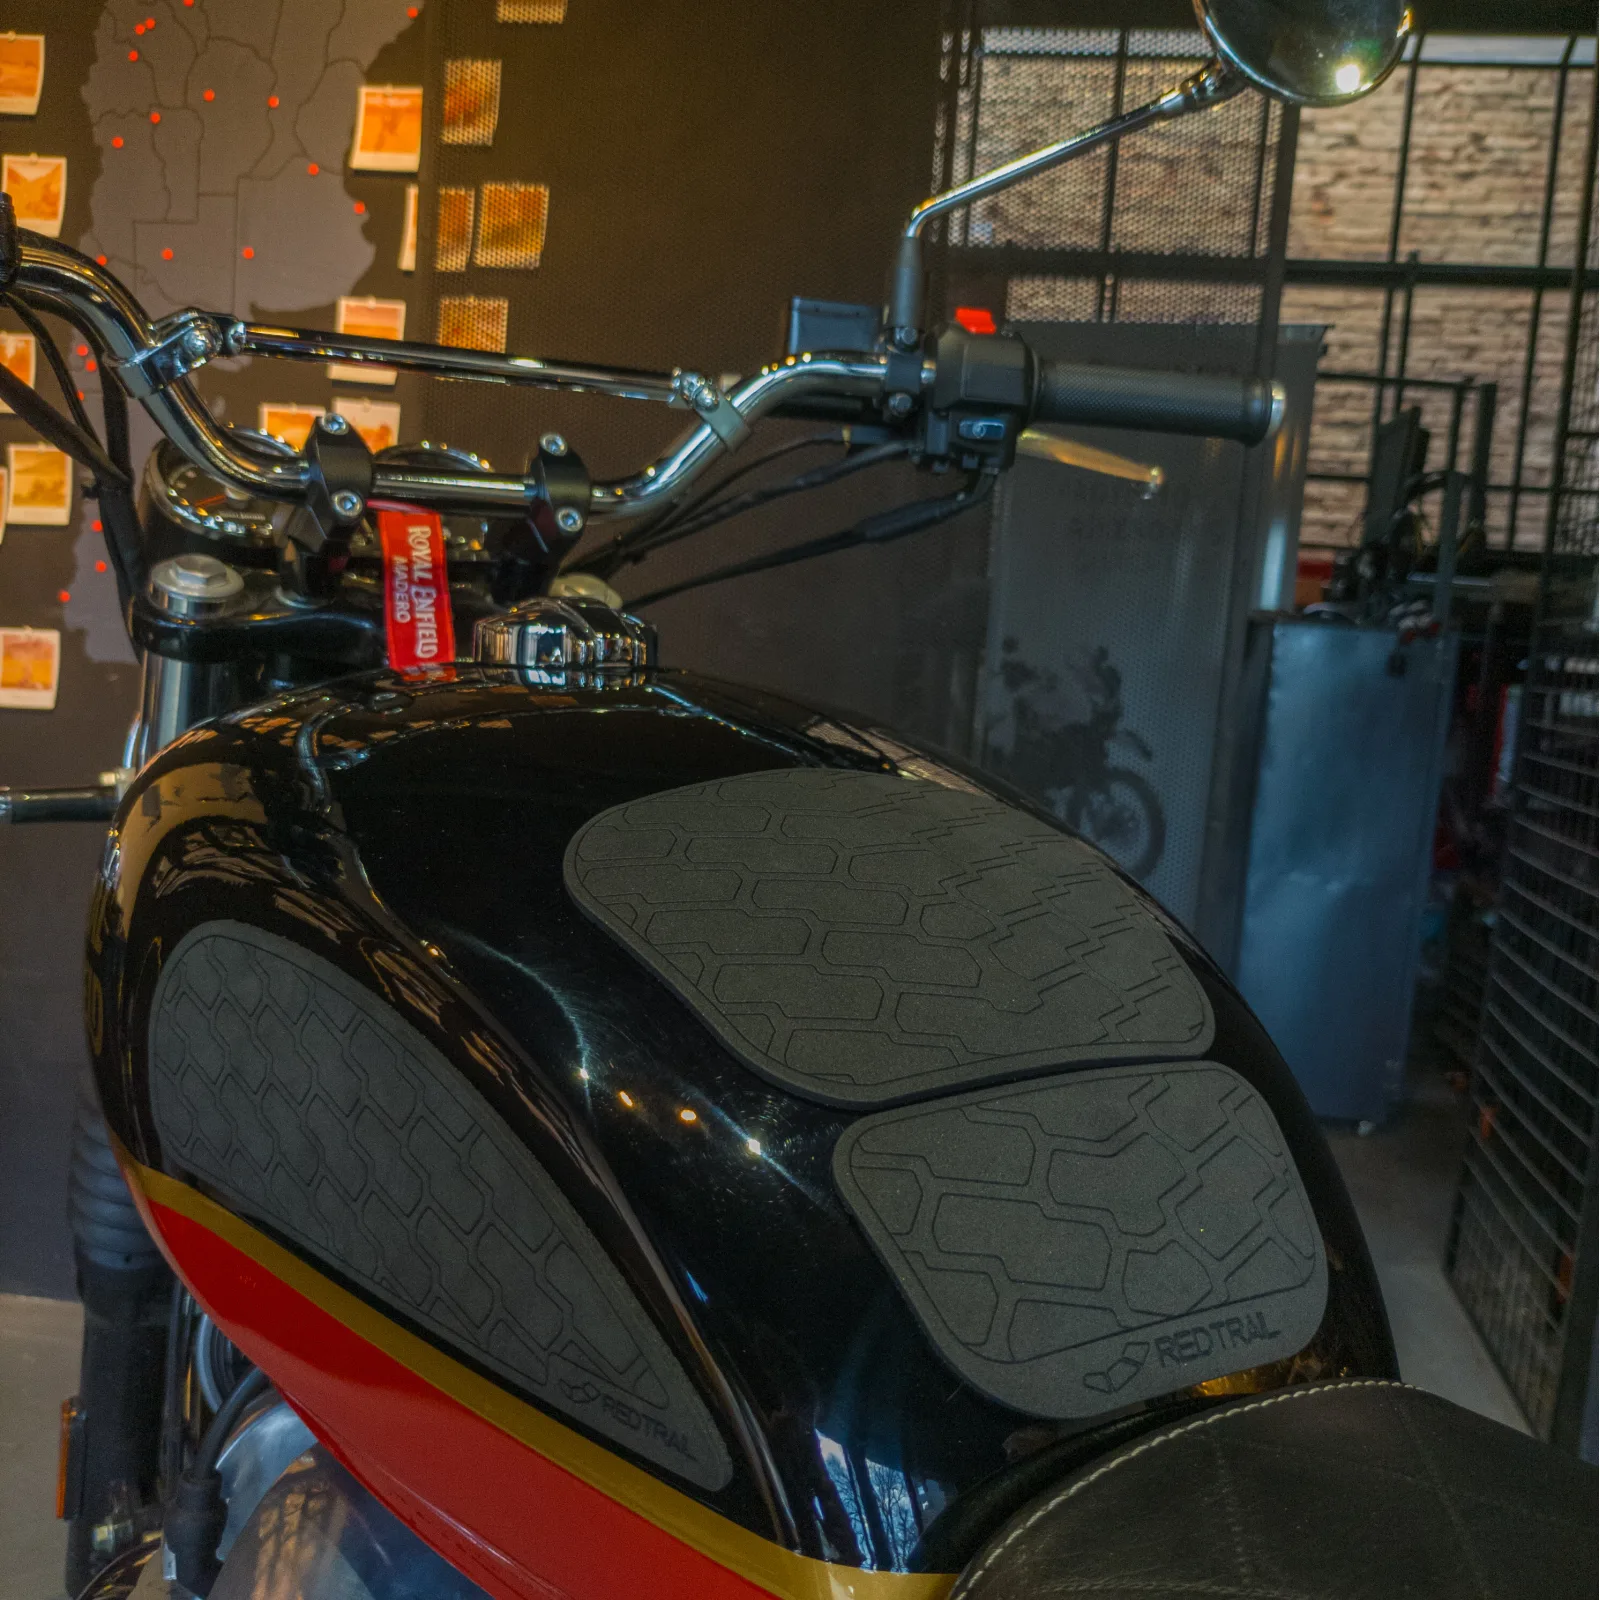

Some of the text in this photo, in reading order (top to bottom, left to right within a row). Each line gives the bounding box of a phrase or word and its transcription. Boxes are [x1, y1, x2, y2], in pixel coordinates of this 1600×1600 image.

[392, 555, 411, 624] MADERO
[407, 525, 439, 659] ROYAL ENFIELD
